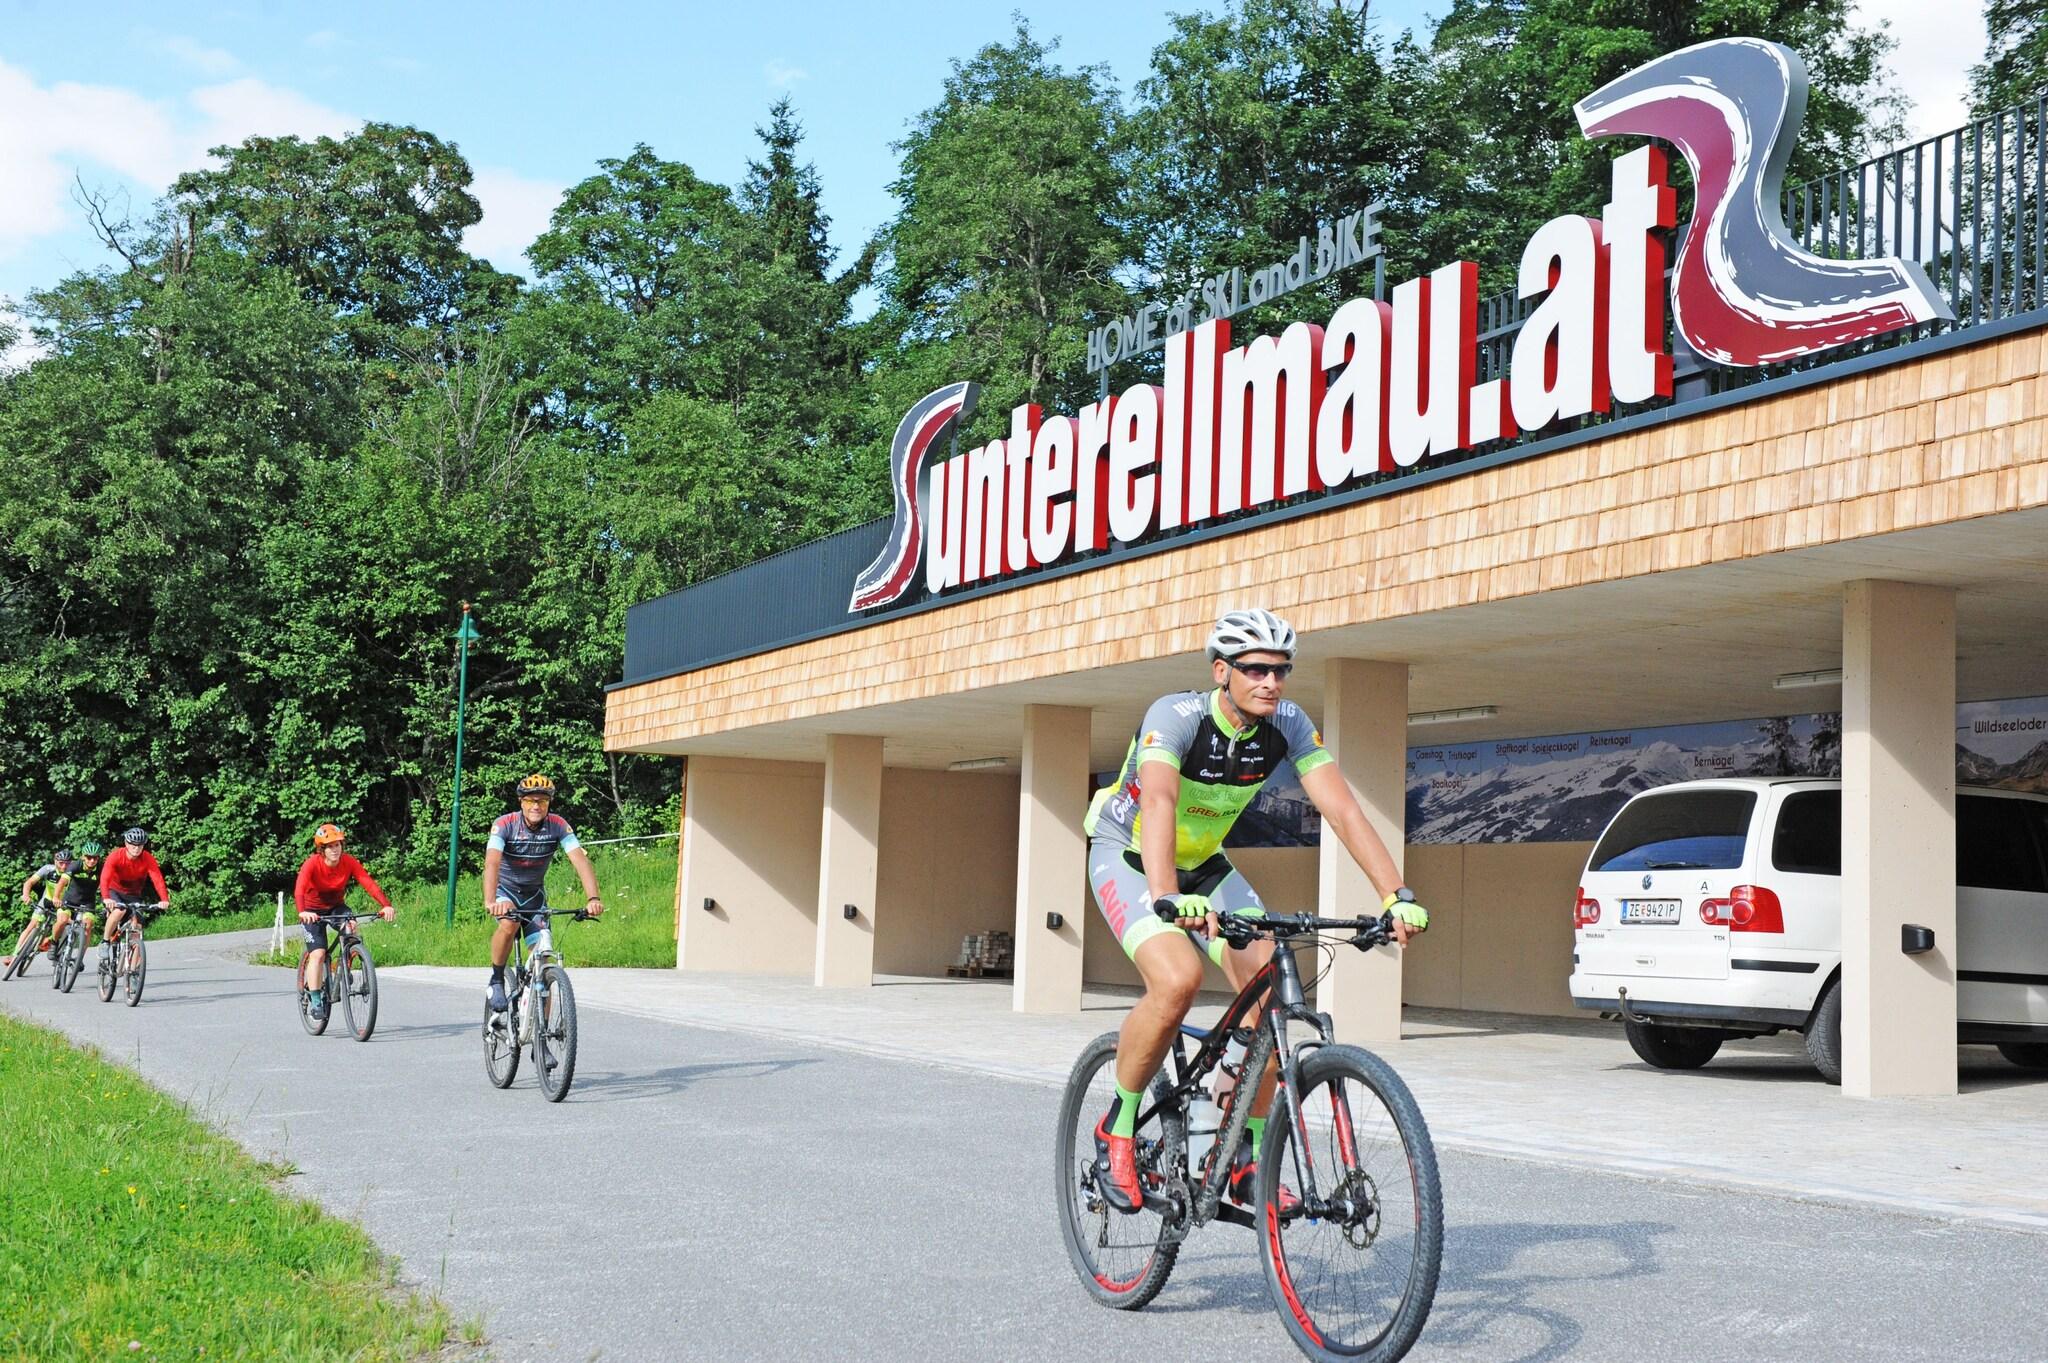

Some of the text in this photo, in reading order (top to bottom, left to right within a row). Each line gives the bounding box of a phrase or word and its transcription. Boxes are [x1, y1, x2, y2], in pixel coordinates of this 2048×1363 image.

[1086, 200, 1387, 375] HOME of SKI and BIKE
[1974, 717, 2047, 734] Wildseeloder
